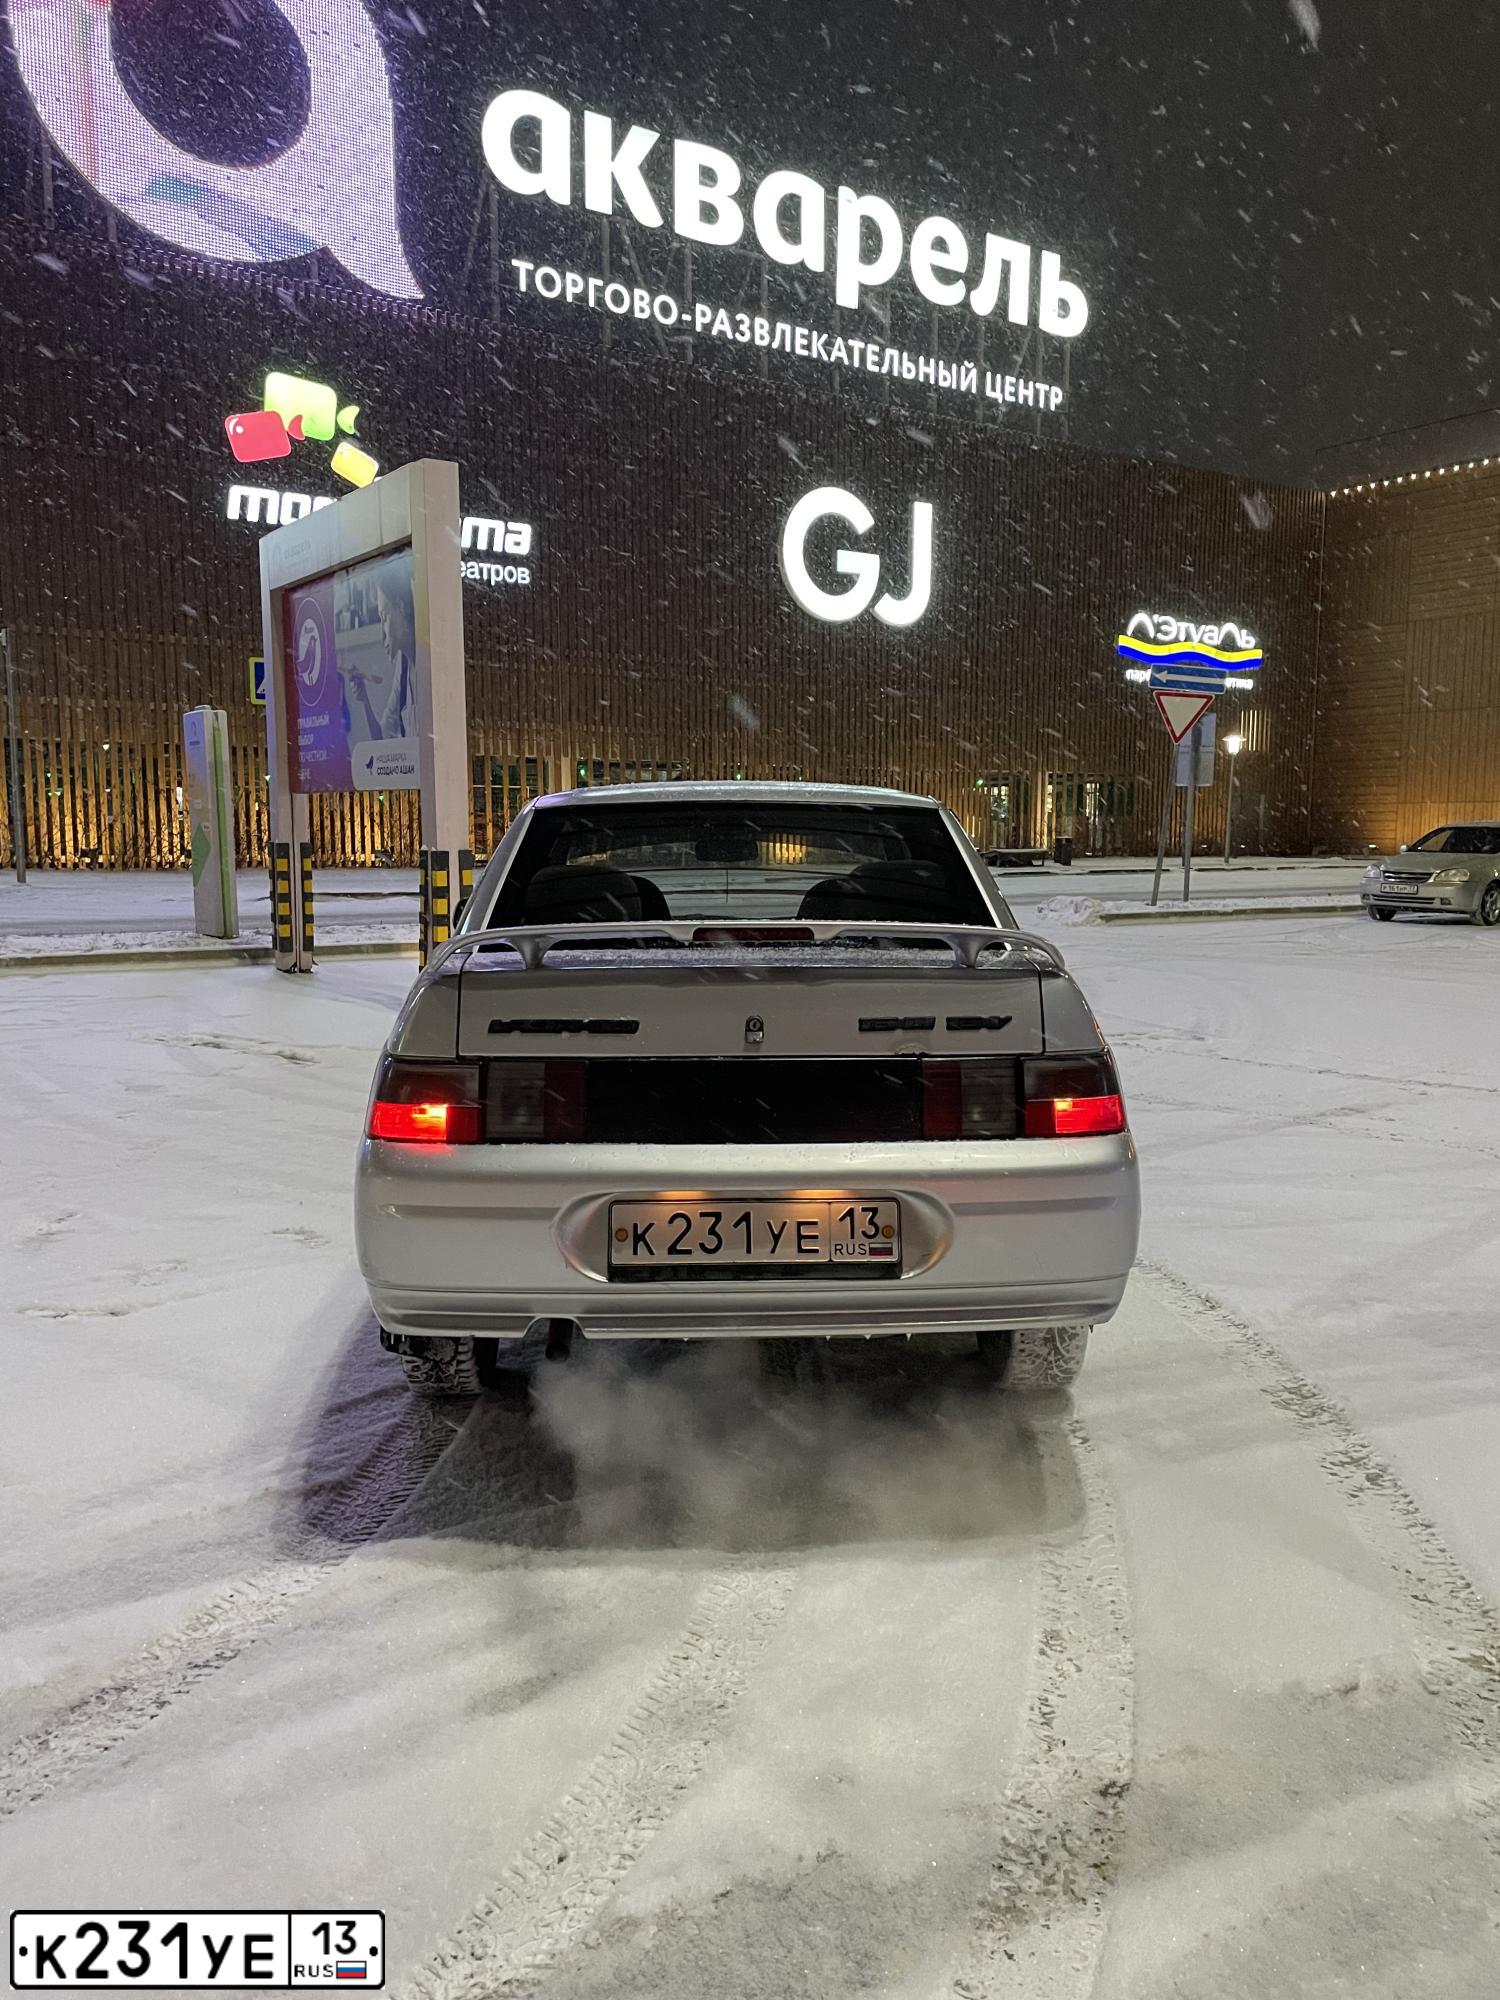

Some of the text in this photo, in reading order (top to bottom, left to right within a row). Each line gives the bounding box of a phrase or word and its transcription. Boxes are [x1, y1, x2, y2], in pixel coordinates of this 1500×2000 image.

[480, 90, 1090, 338] акварель
[511, 258, 1064, 412] ТОРГОВО-РАЗВЛЕКАТЕЛЬНЫЙ ЦЕНТР
[782, 486, 933, 626] GJ
[834, 1242, 868, 1256] RUS
[838, 1206, 881, 1240] 13
